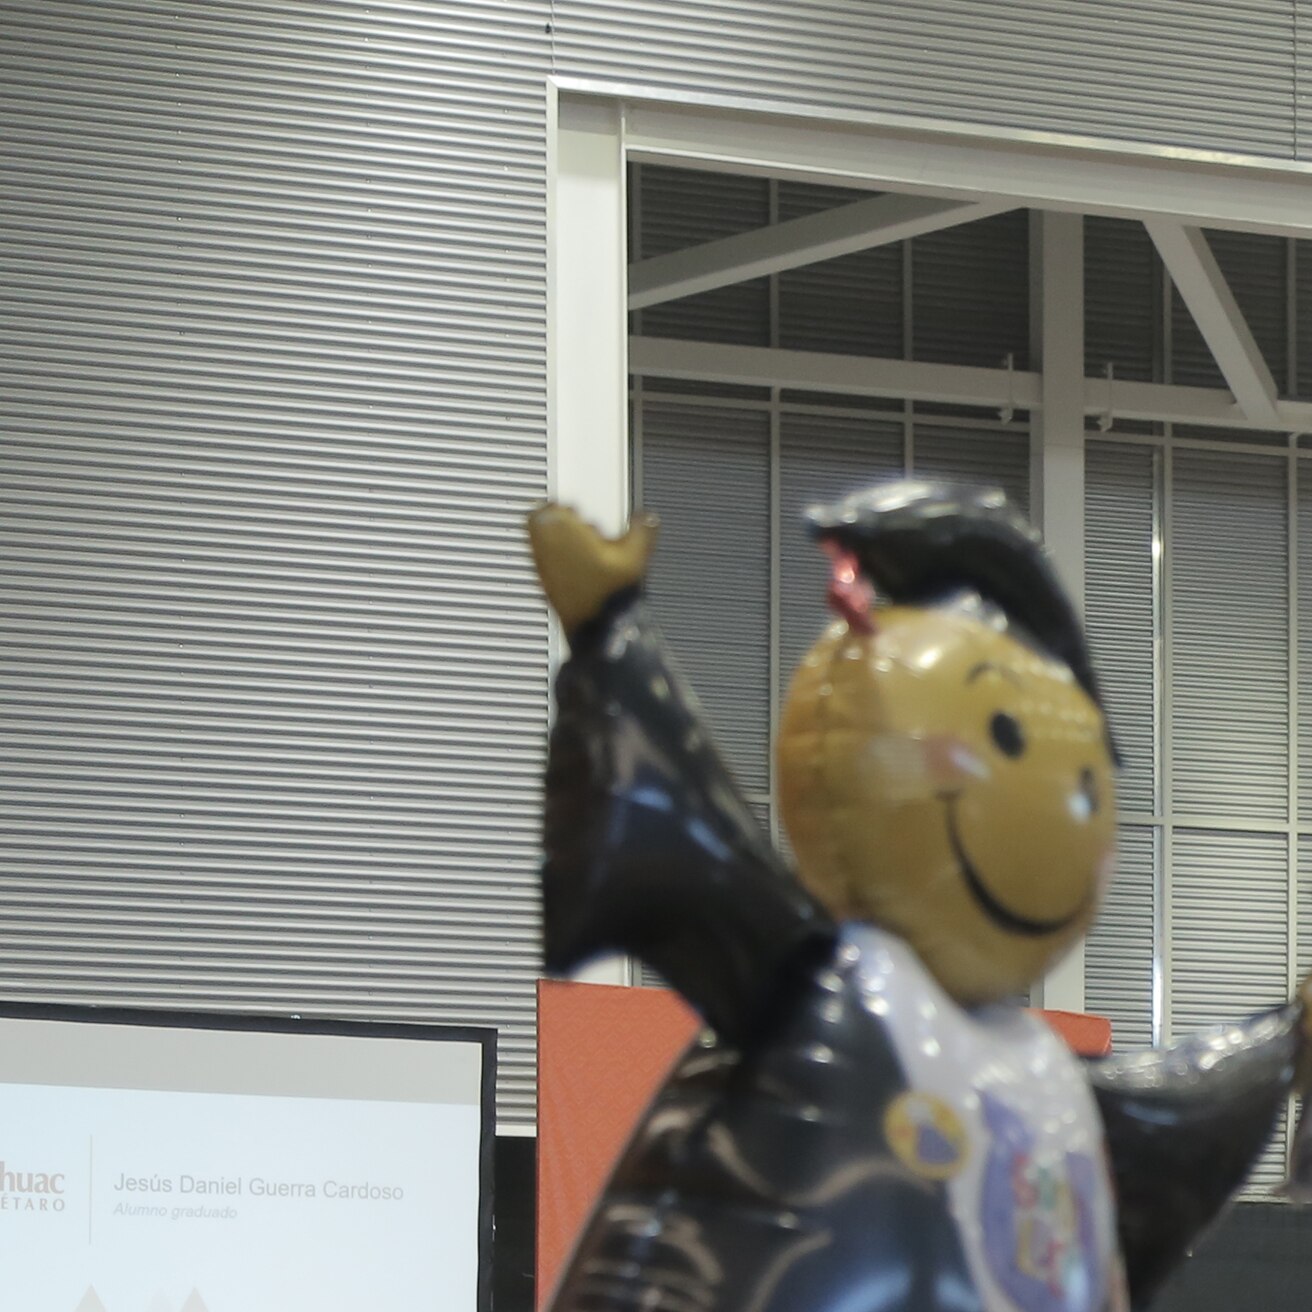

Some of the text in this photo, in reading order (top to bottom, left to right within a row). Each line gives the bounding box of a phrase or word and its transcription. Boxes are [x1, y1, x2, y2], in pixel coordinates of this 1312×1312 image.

[113, 1172, 404, 1201] Jesús Daniel Guerra Cardoso
[113, 1202, 238, 1221] Alumno graduado
